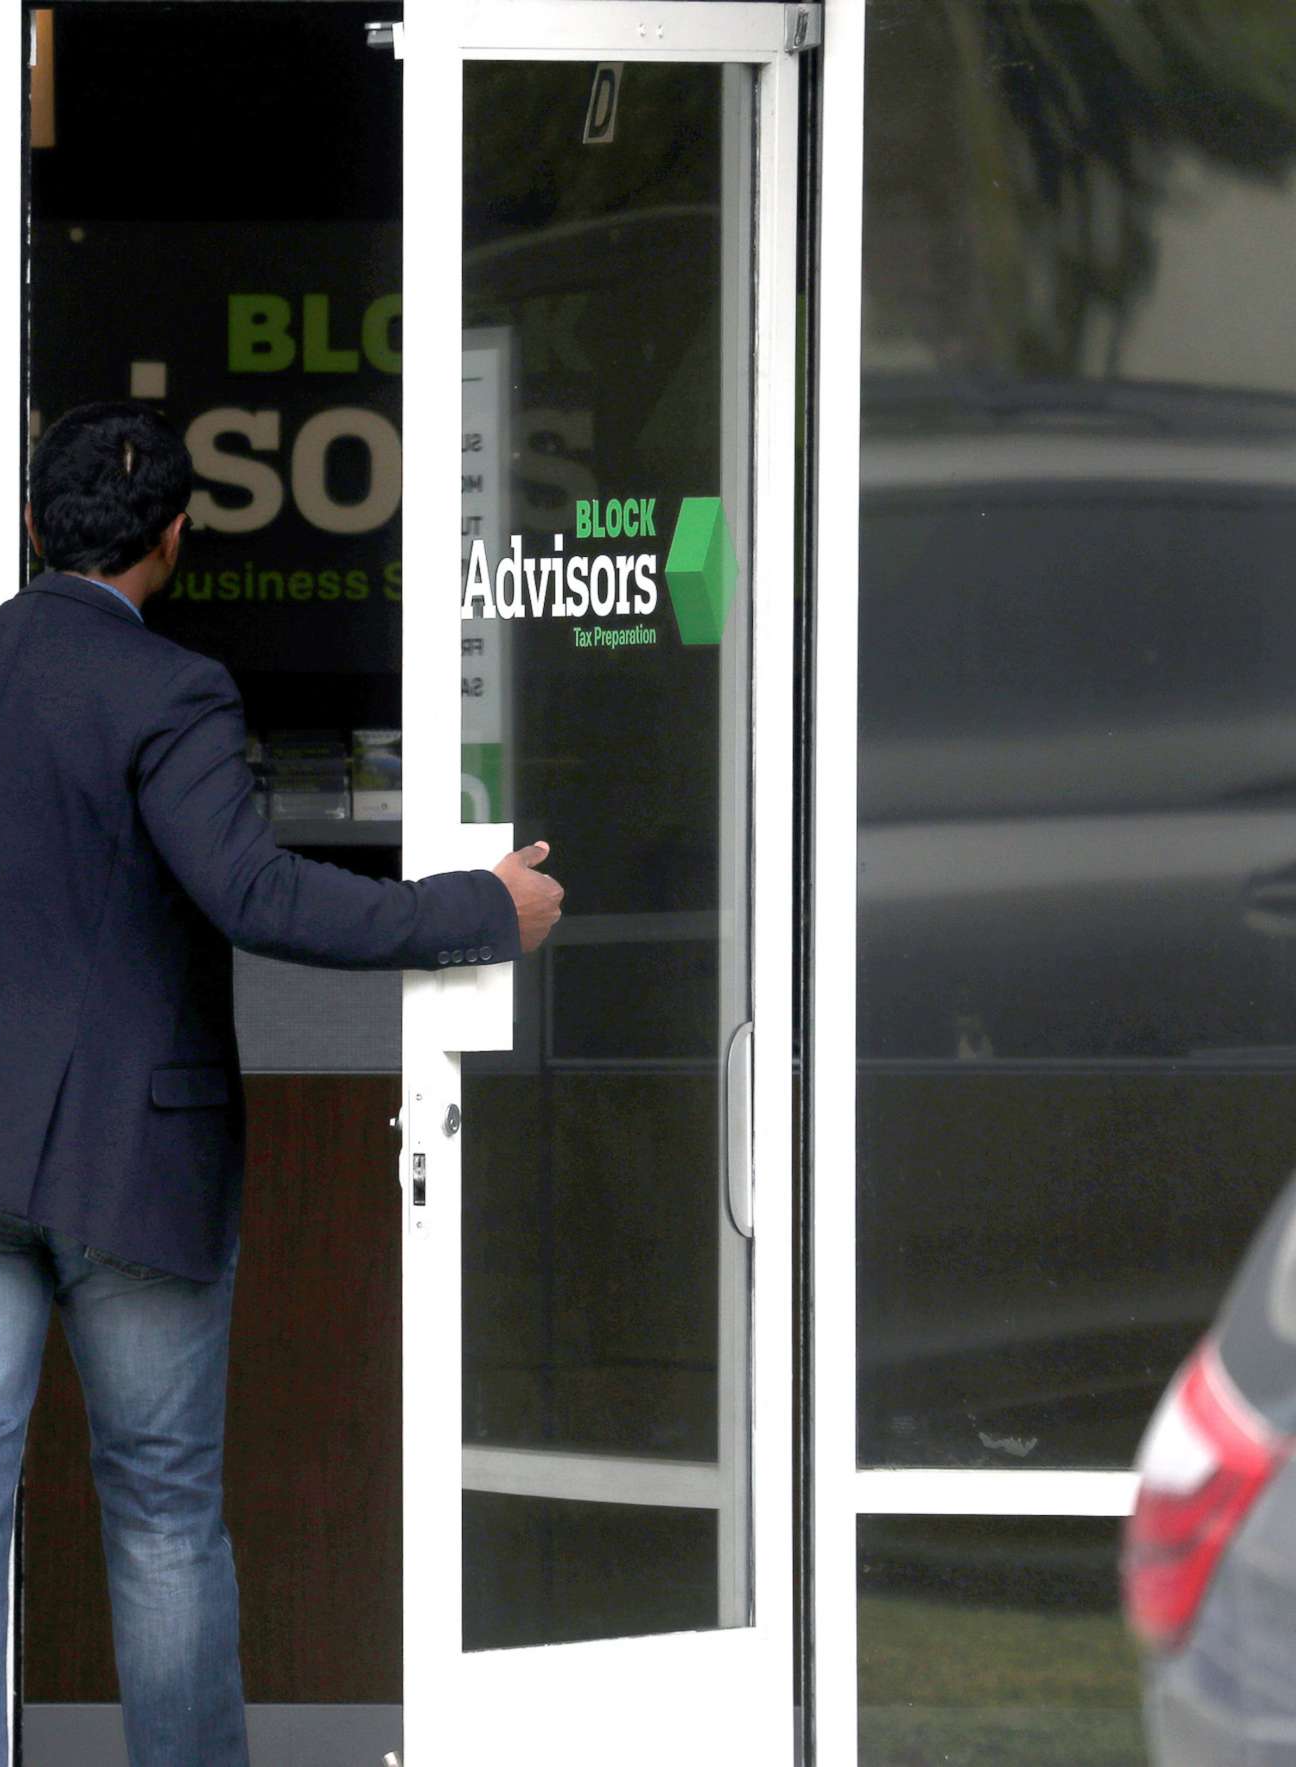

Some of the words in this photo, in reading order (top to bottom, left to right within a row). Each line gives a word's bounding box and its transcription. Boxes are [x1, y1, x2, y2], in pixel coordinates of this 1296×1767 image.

[576, 498, 657, 539] BLOCK
[461, 533, 658, 620] Advisors
[573, 627, 593, 648] Tax
[594, 624, 657, 650] Preparation
